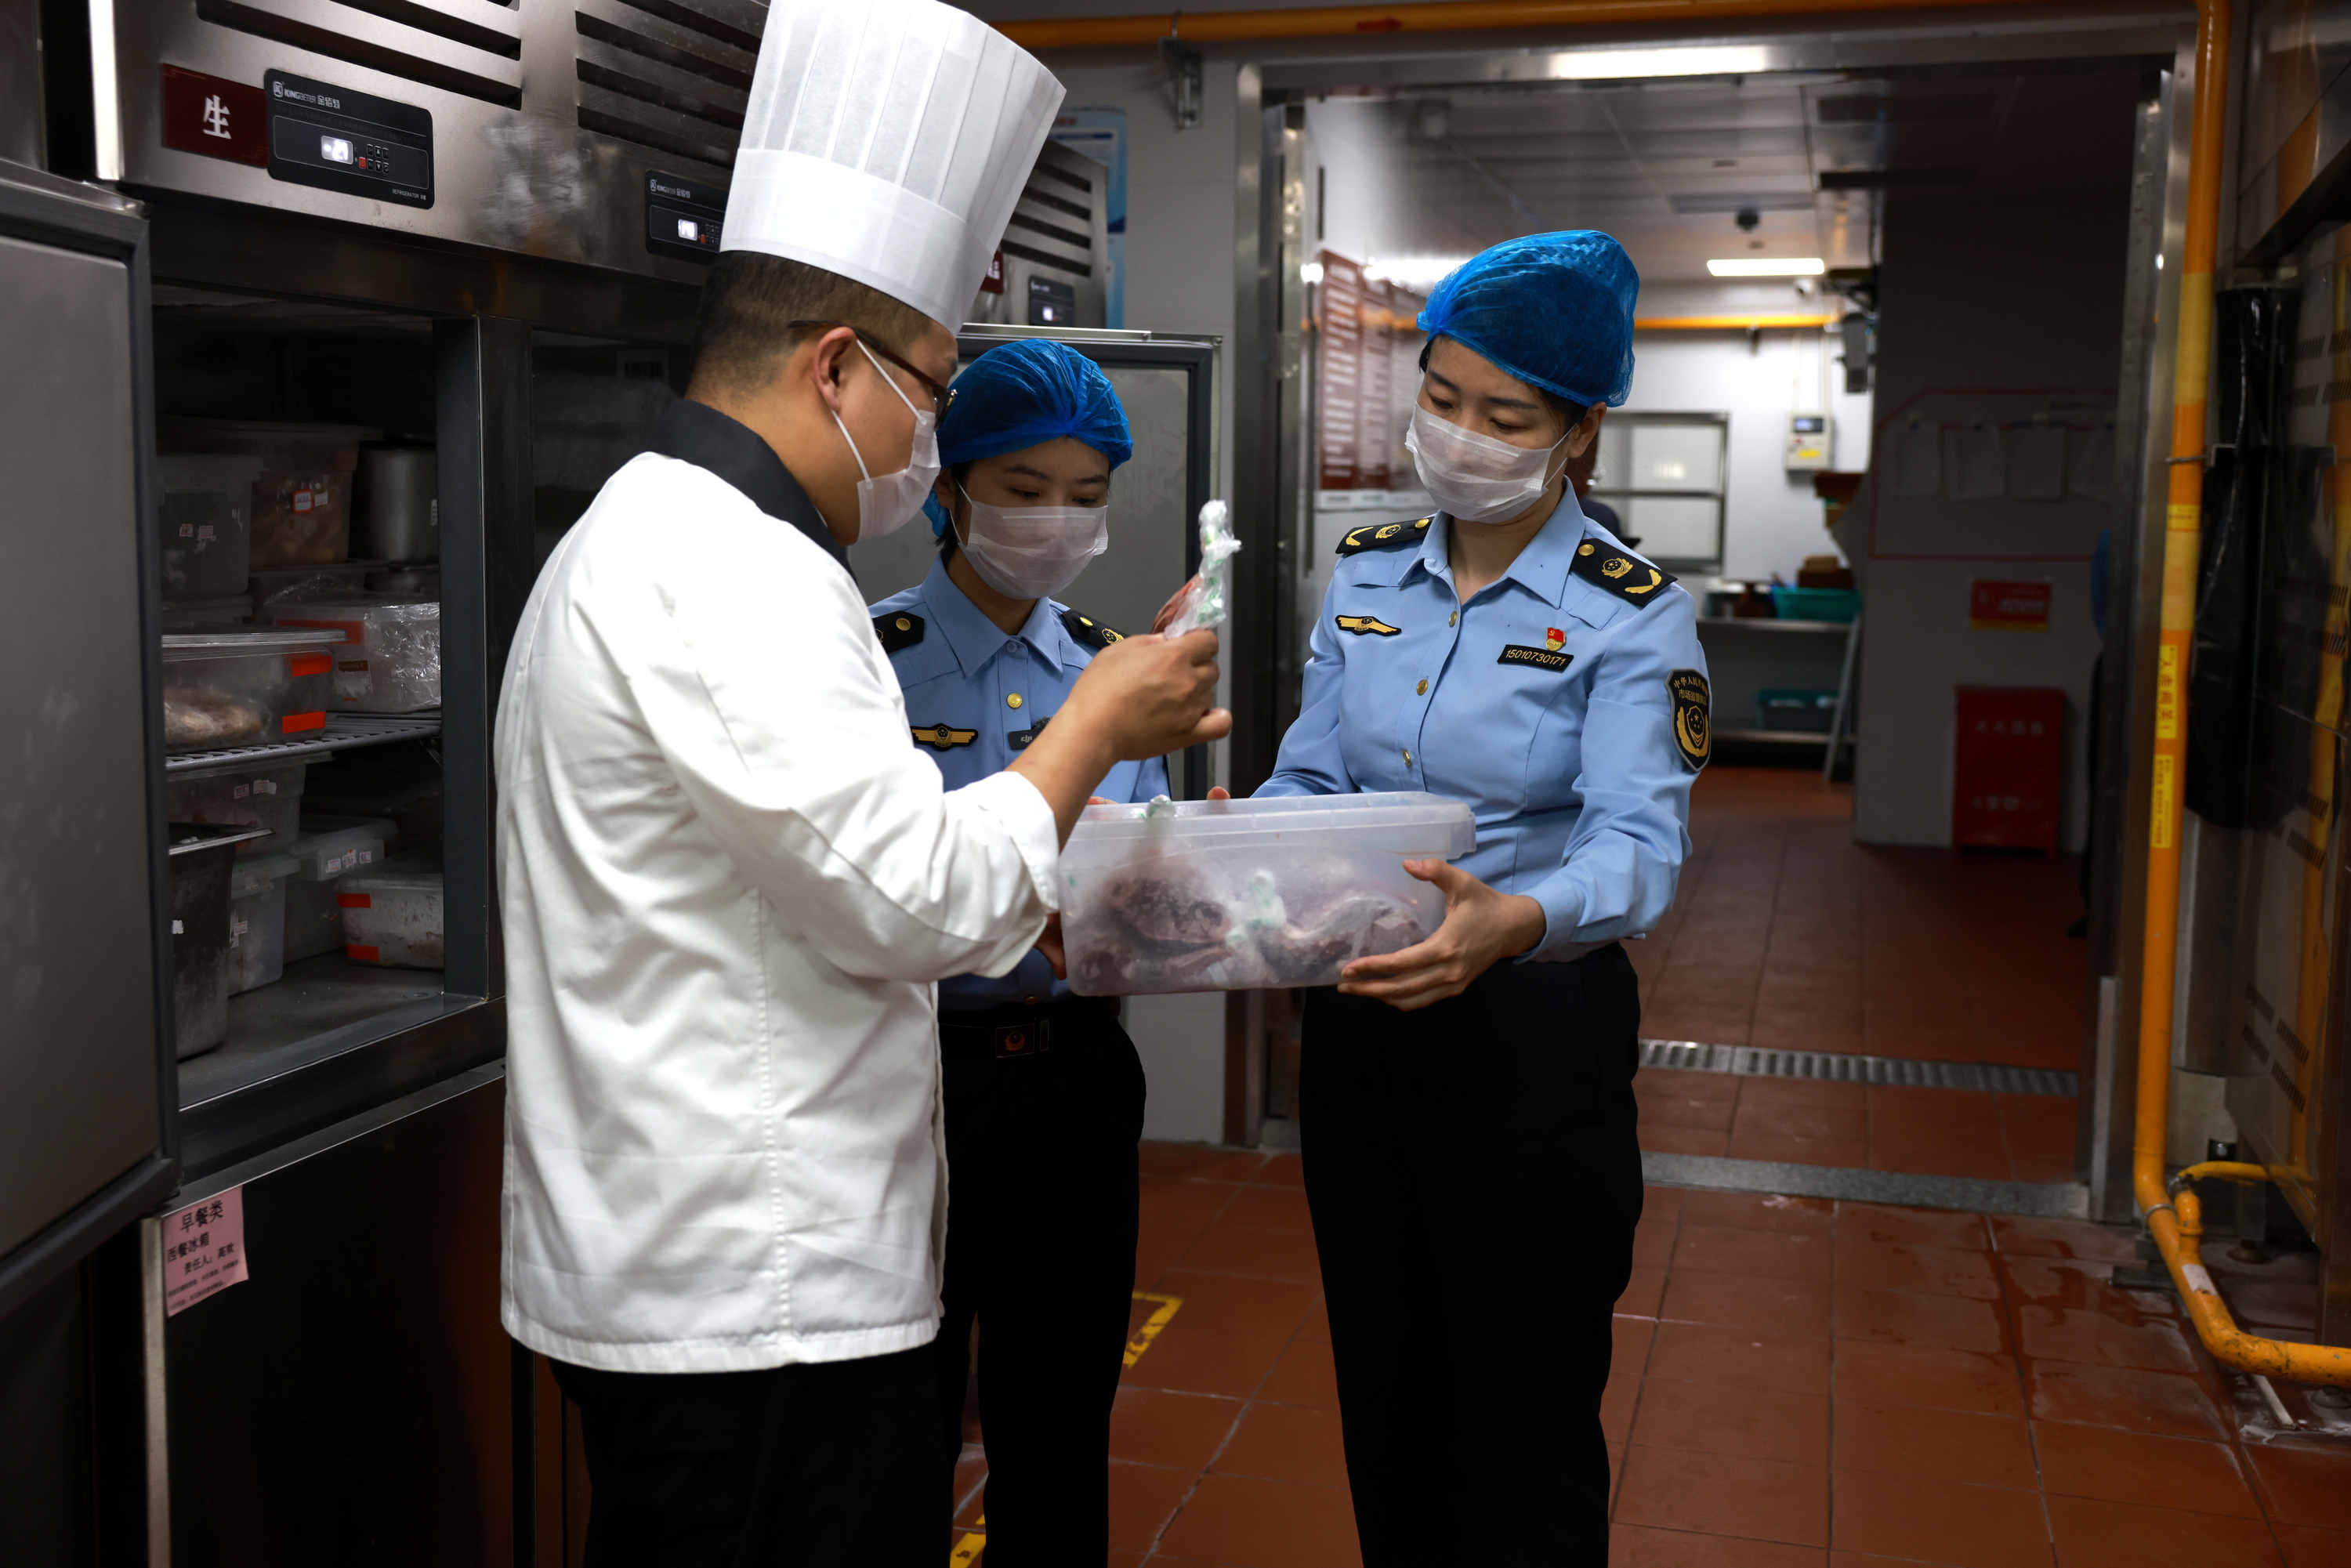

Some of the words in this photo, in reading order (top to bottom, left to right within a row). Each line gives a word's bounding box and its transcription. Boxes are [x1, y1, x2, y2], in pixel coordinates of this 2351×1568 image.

[203, 94, 232, 139] 生
[393, 189, 419, 198] REFRIGERATOR
[1505, 650, 1567, 666] 15010730171
[181, 1200, 223, 1233] 早餐类
